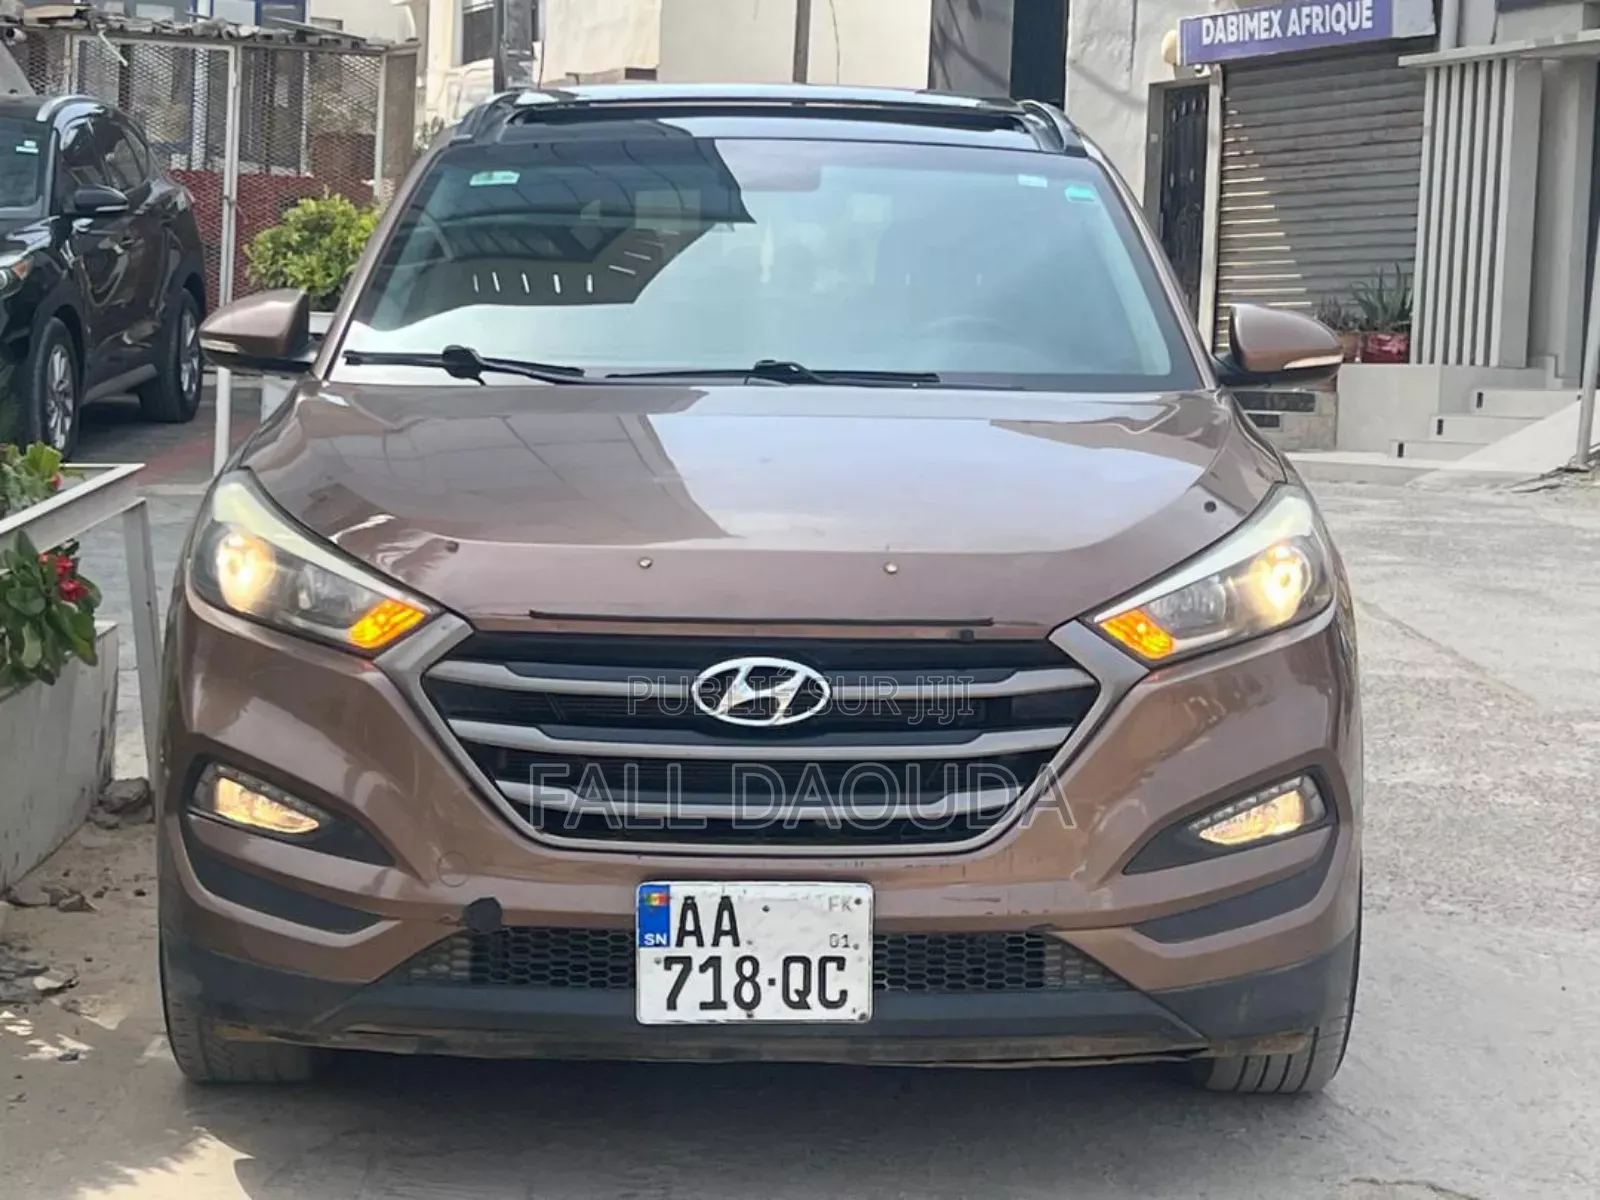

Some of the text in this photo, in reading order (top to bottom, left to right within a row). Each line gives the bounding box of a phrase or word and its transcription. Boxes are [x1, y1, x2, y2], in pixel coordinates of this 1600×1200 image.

[1202, 0, 1373, 45] DABIMEX AFRIQUE
[644, 932, 668, 946] SN
[675, 895, 741, 948] AA
